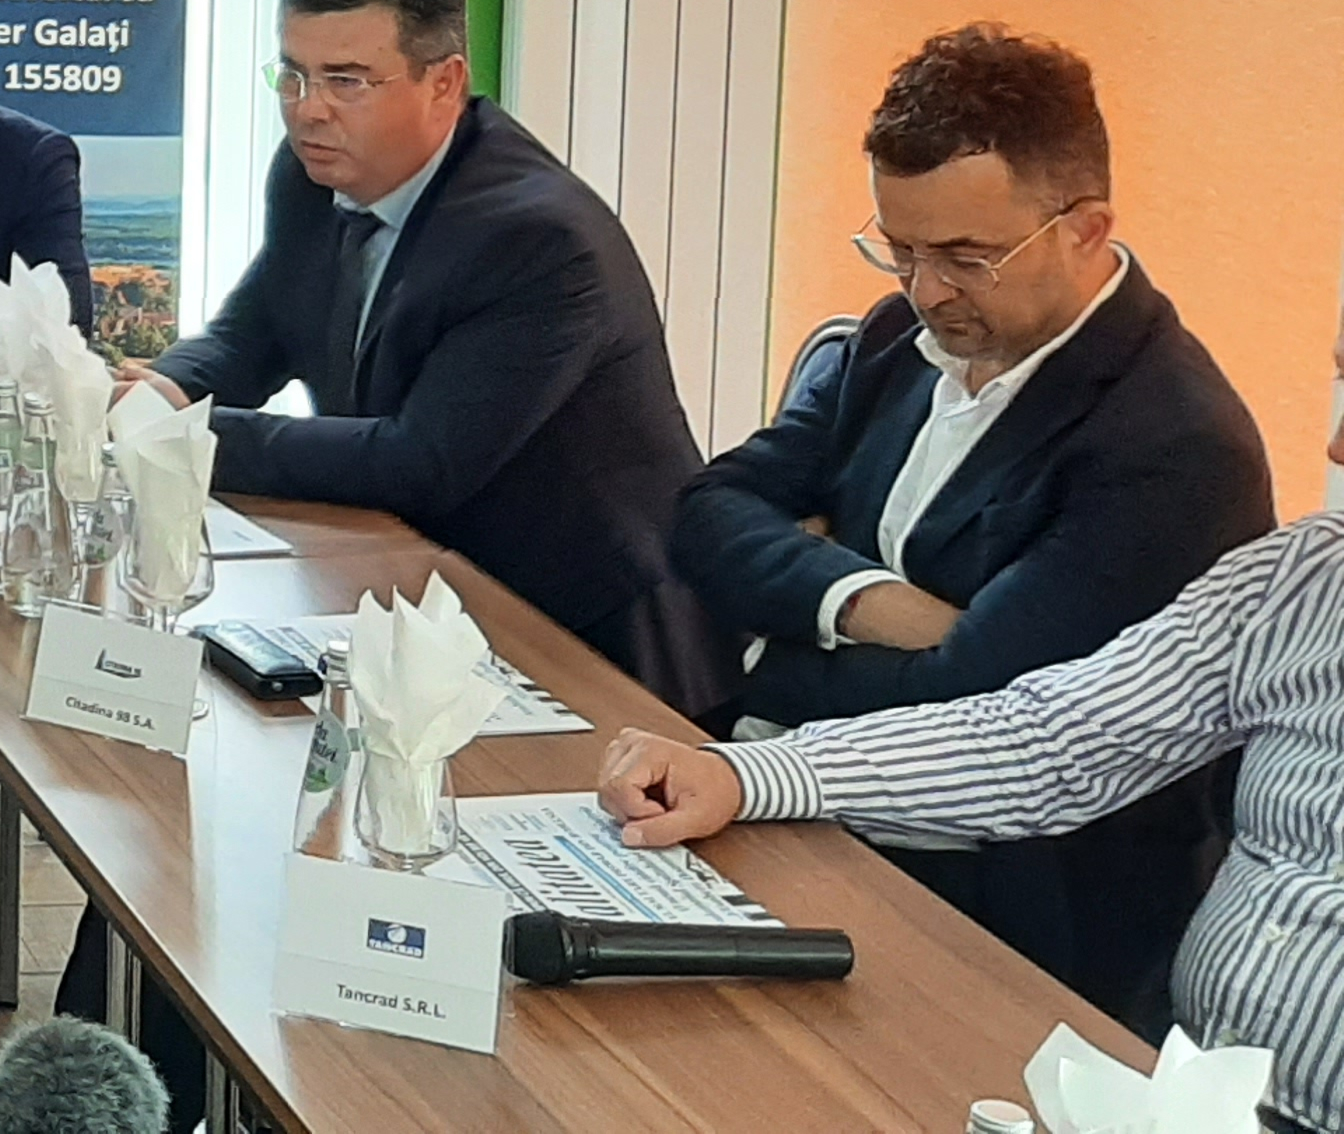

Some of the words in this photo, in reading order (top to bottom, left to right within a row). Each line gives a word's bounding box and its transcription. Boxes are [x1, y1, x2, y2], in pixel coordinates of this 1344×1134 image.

[34, 18, 130, 53] Galați
[4, 64, 123, 92] 155809
[65, 695, 113, 720] Citadina
[116, 710, 131, 724] 98
[133, 714, 157, 731] S.A.
[336, 983, 399, 1009] Tancrad
[402, 998, 447, 1020] S.R.L.
